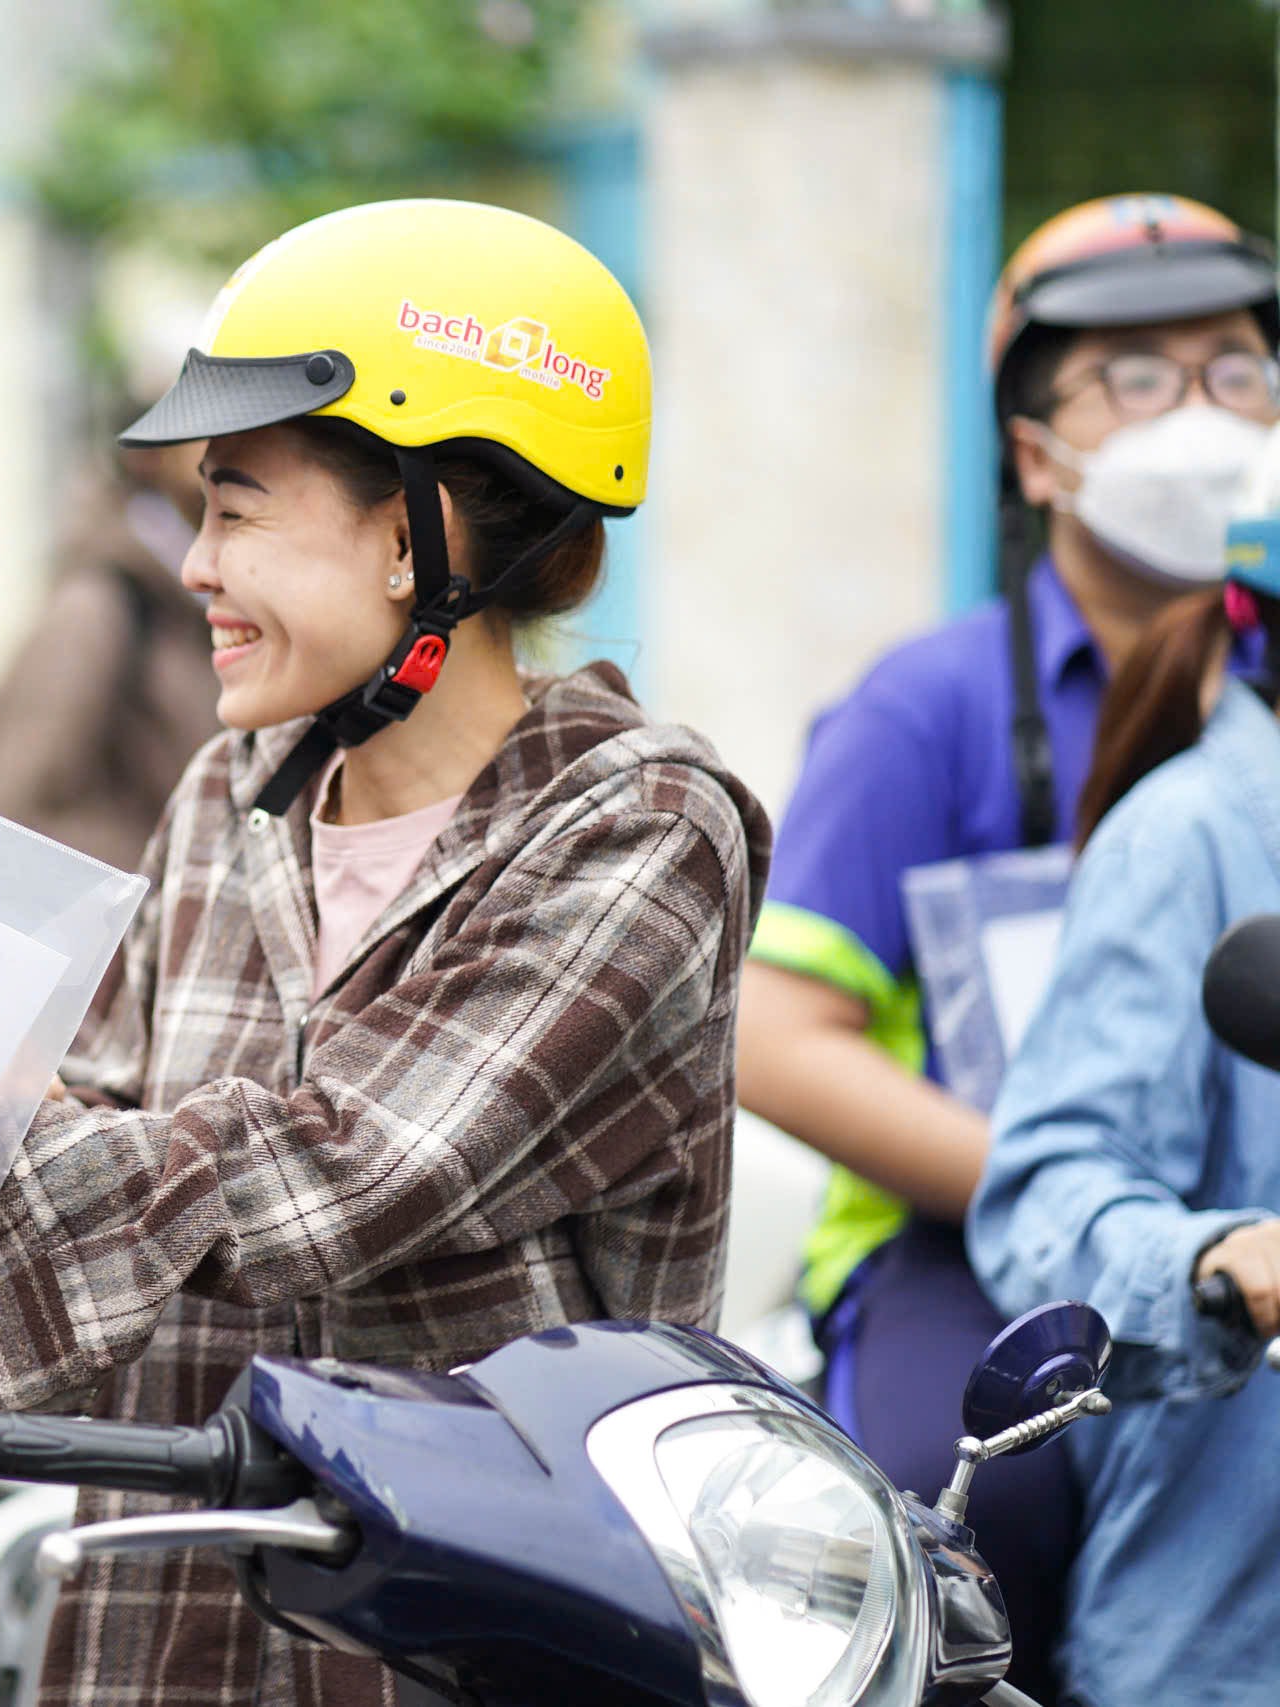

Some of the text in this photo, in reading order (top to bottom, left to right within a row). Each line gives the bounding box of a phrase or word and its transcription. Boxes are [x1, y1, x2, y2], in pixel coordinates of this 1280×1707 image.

[400, 302, 604, 398] bach long
[520, 367, 560, 388] mobile
